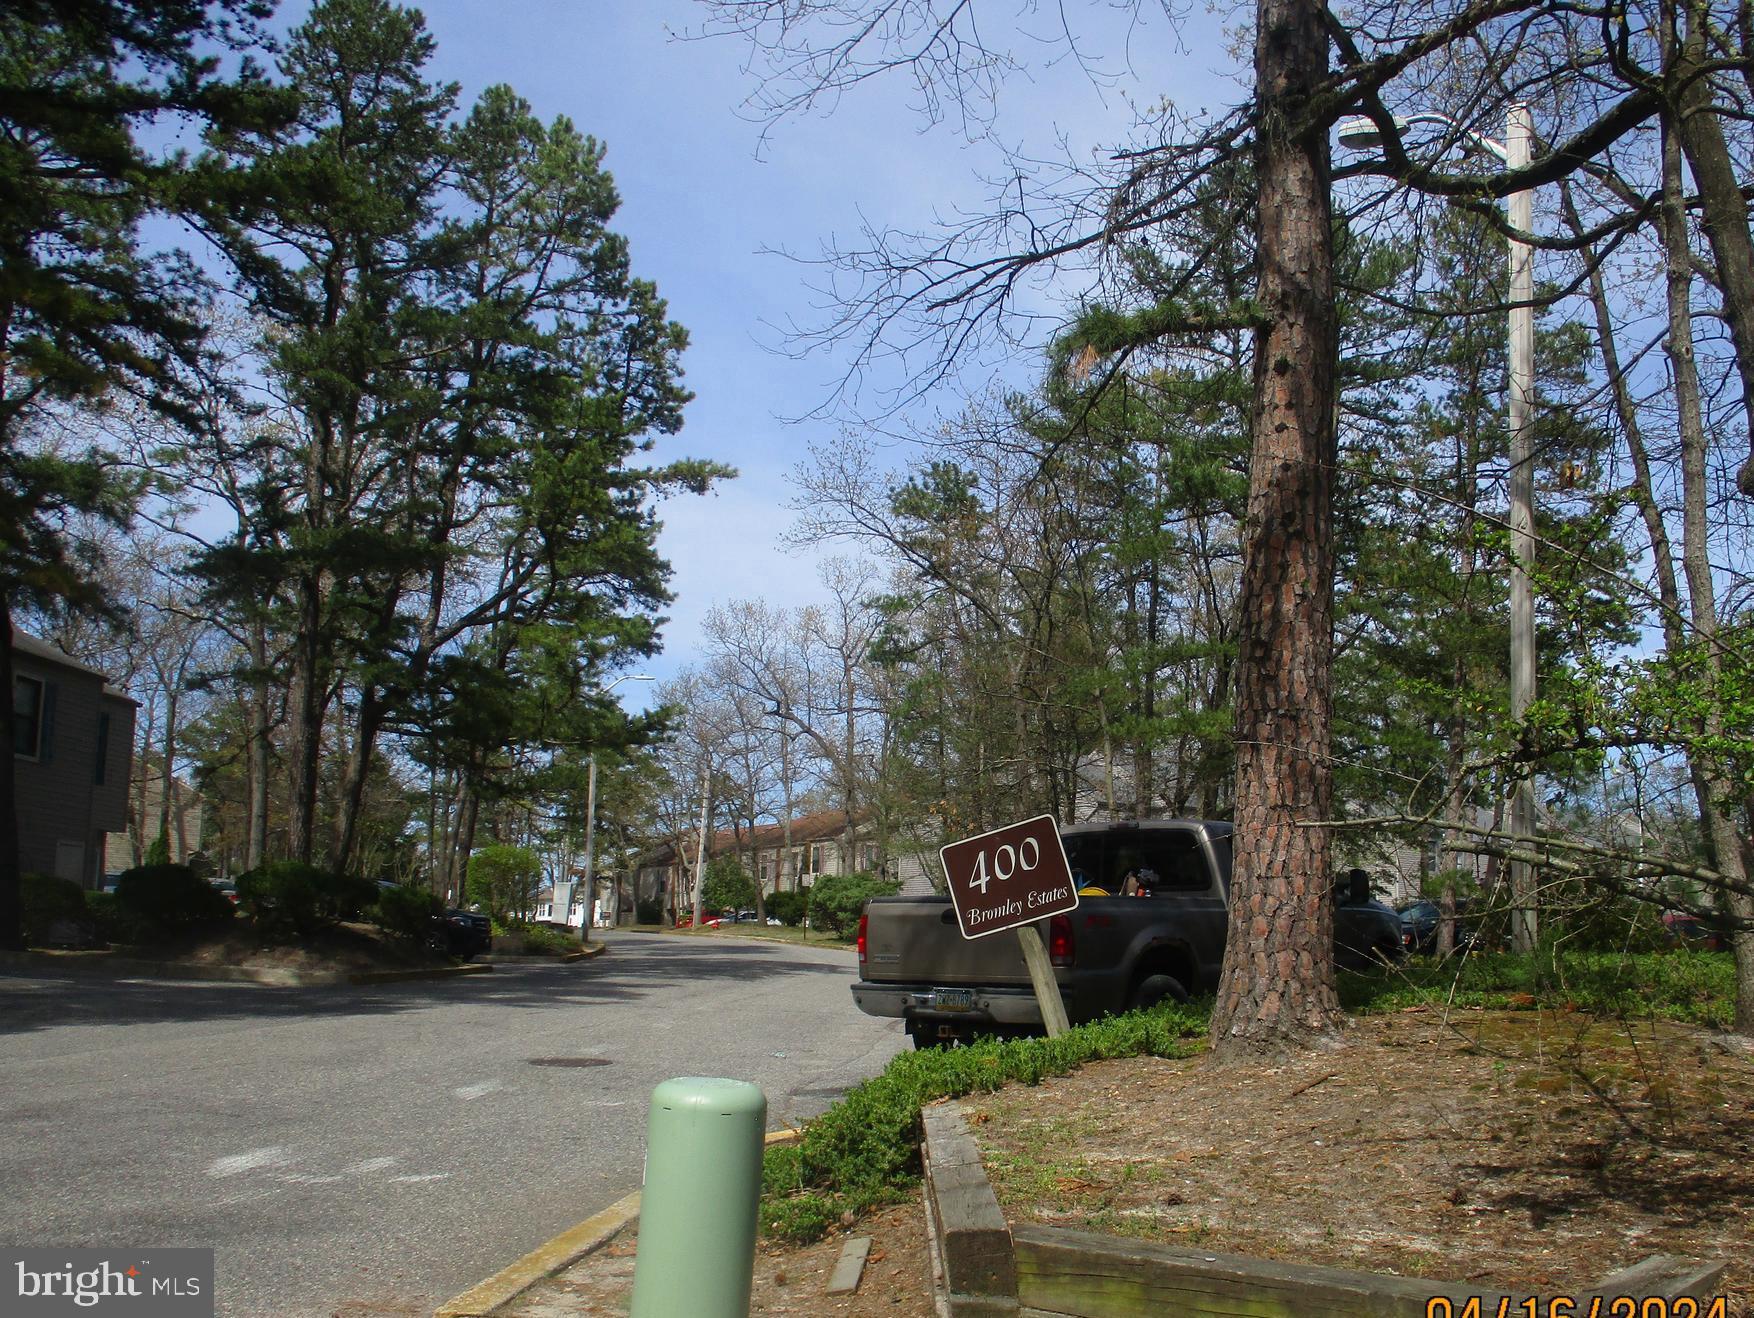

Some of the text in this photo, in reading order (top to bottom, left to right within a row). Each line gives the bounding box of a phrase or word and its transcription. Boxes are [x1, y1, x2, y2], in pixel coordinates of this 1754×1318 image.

[969, 837, 1040, 894] 400
[967, 886, 1068, 925] Bromley Estates
